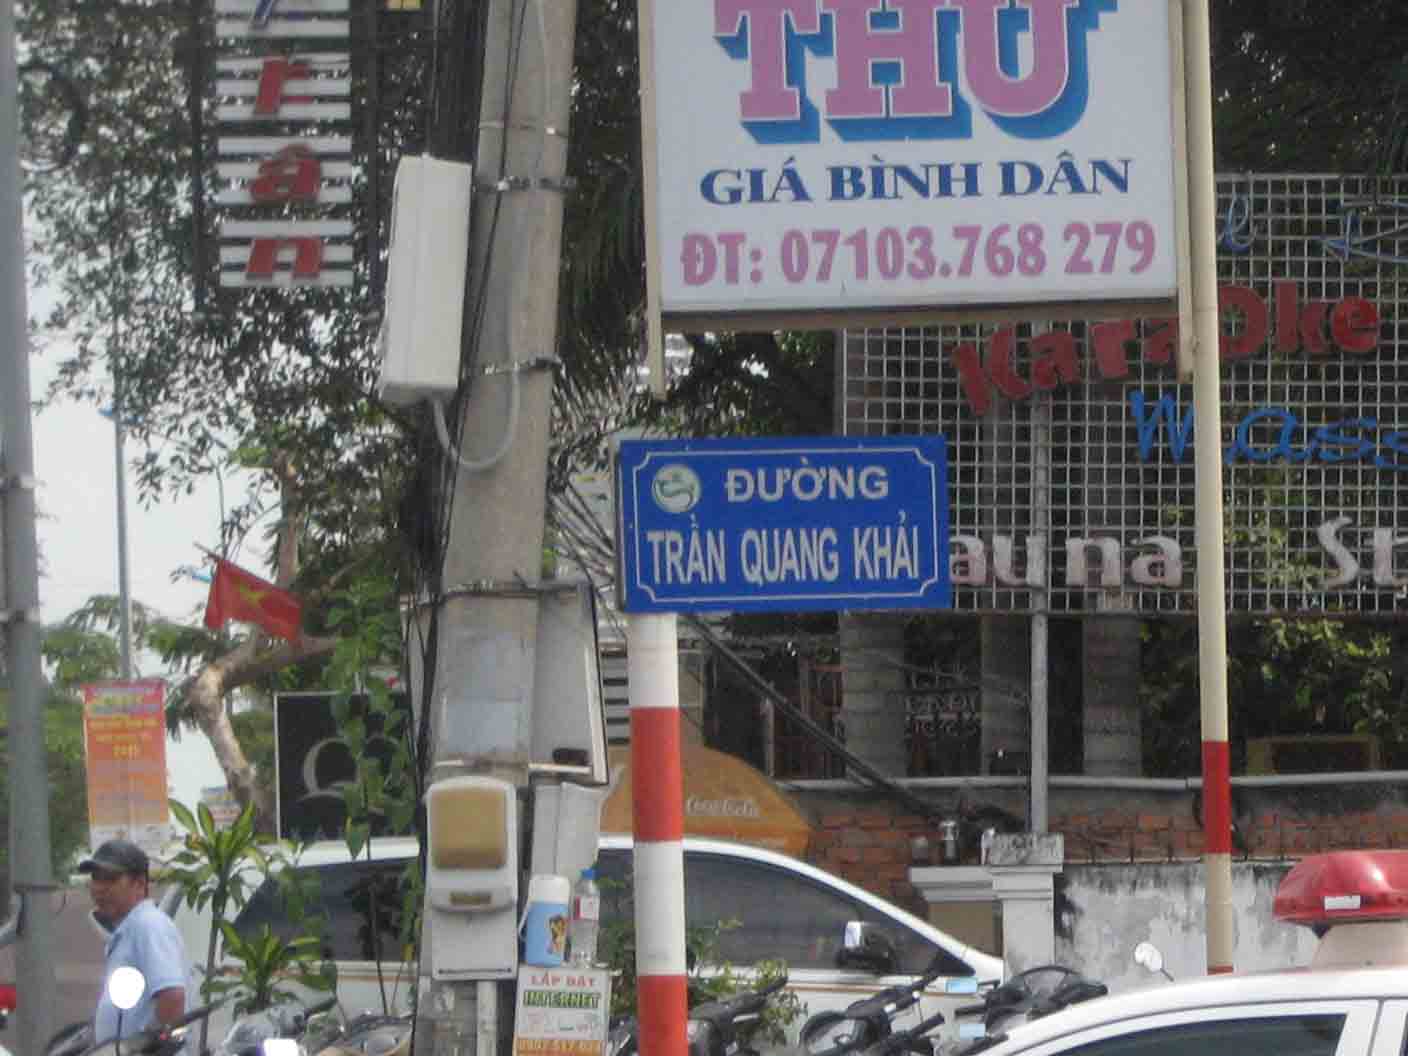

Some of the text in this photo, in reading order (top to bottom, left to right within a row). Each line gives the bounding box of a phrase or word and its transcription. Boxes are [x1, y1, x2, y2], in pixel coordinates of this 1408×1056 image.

[700, 149, 1132, 204] GIÁ BÌNH DÂN
[680, 231, 764, 287] ĐT:
[780, 223, 1046, 284] 07103.768
[1062, 220, 1157, 275] 279
[725, 456, 889, 503] ĐƯỜNG
[647, 508, 920, 587] TRẦN QUANG KHẢI
[950, 534, 1184, 588] auna
